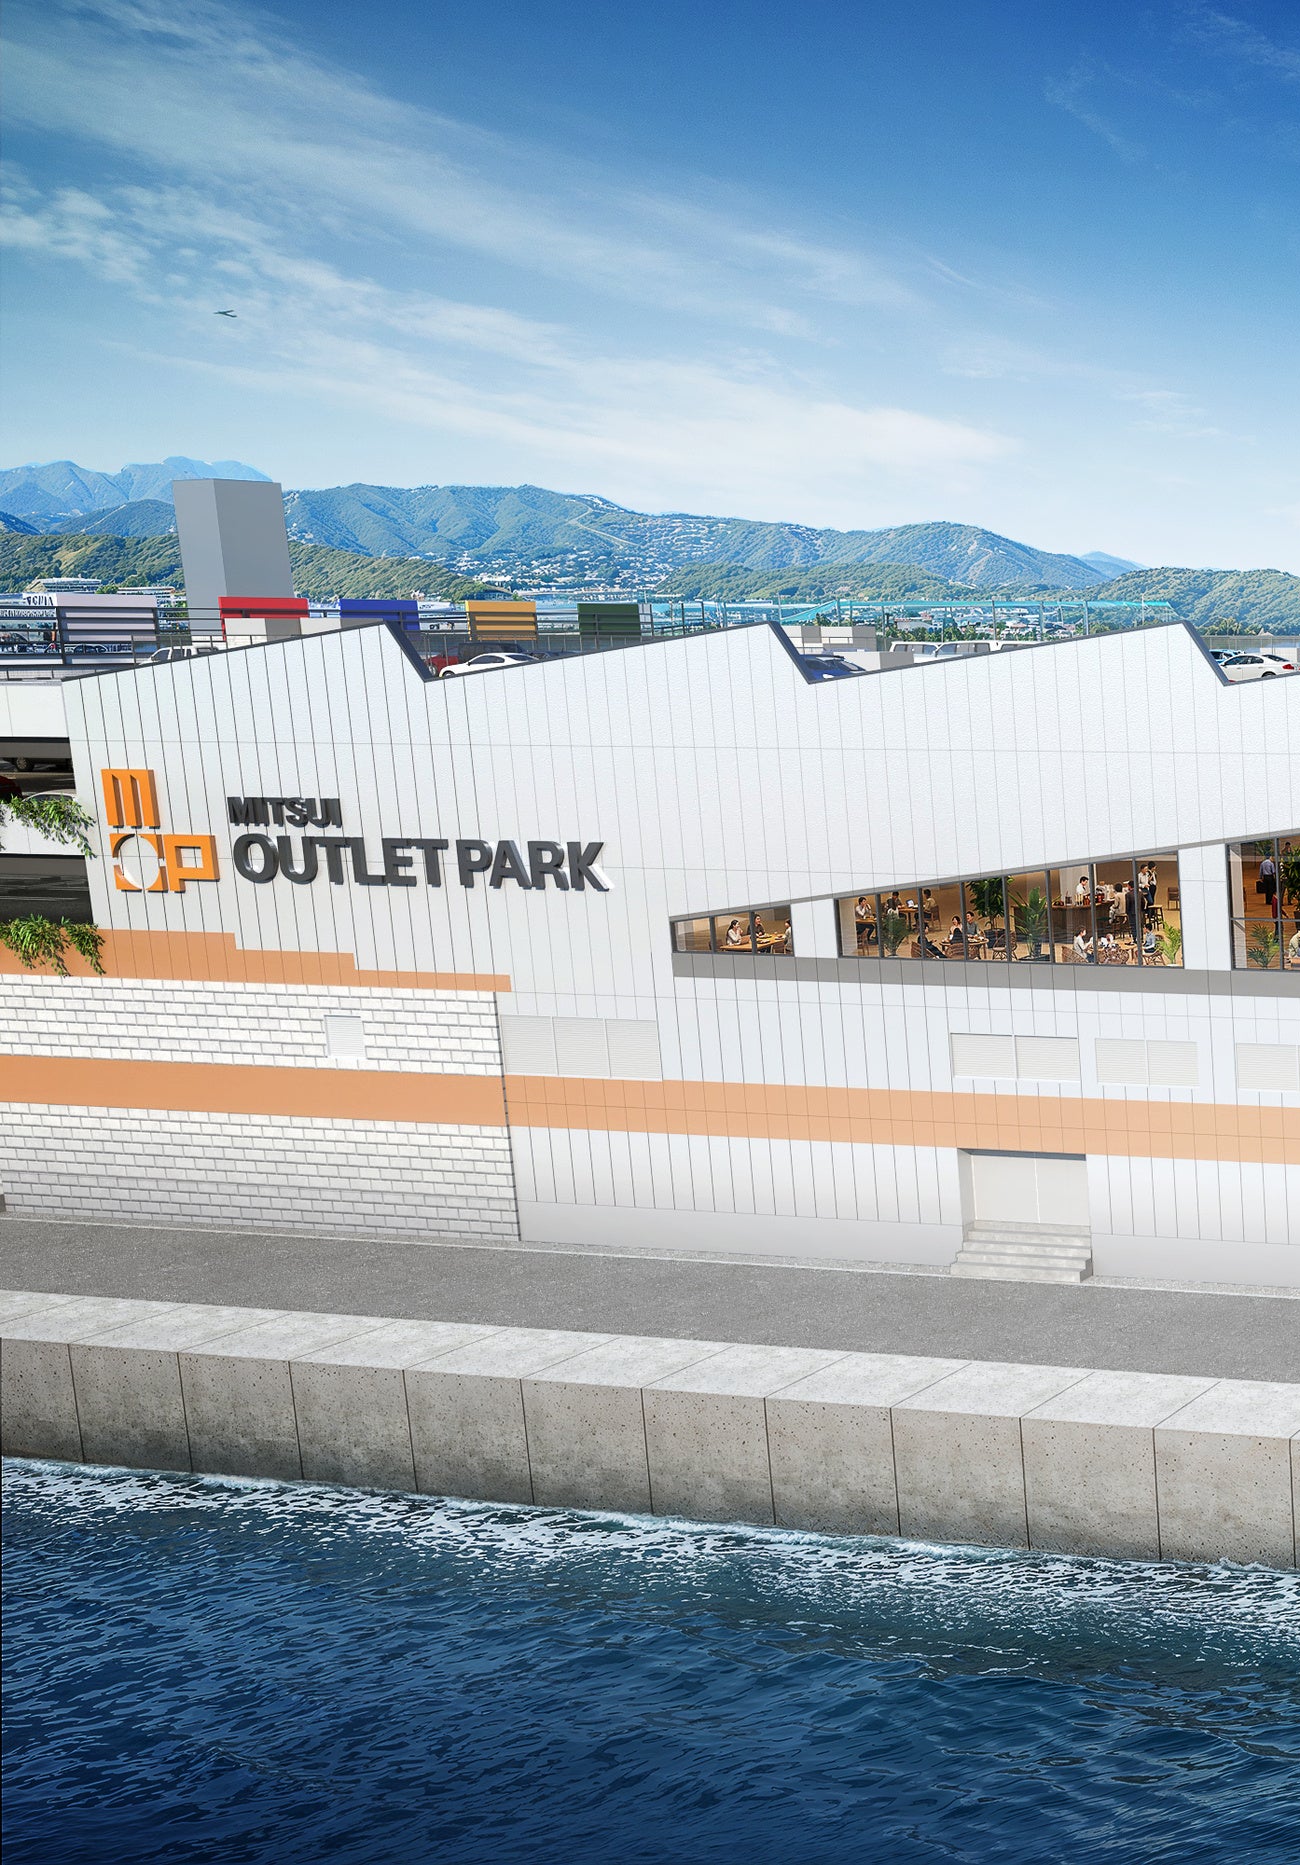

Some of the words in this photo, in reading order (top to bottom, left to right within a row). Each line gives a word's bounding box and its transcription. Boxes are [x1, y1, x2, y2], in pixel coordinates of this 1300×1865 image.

[227, 796, 343, 828] MITSUI
[233, 833, 449, 888] OUTLET
[456, 839, 611, 892] PARK
